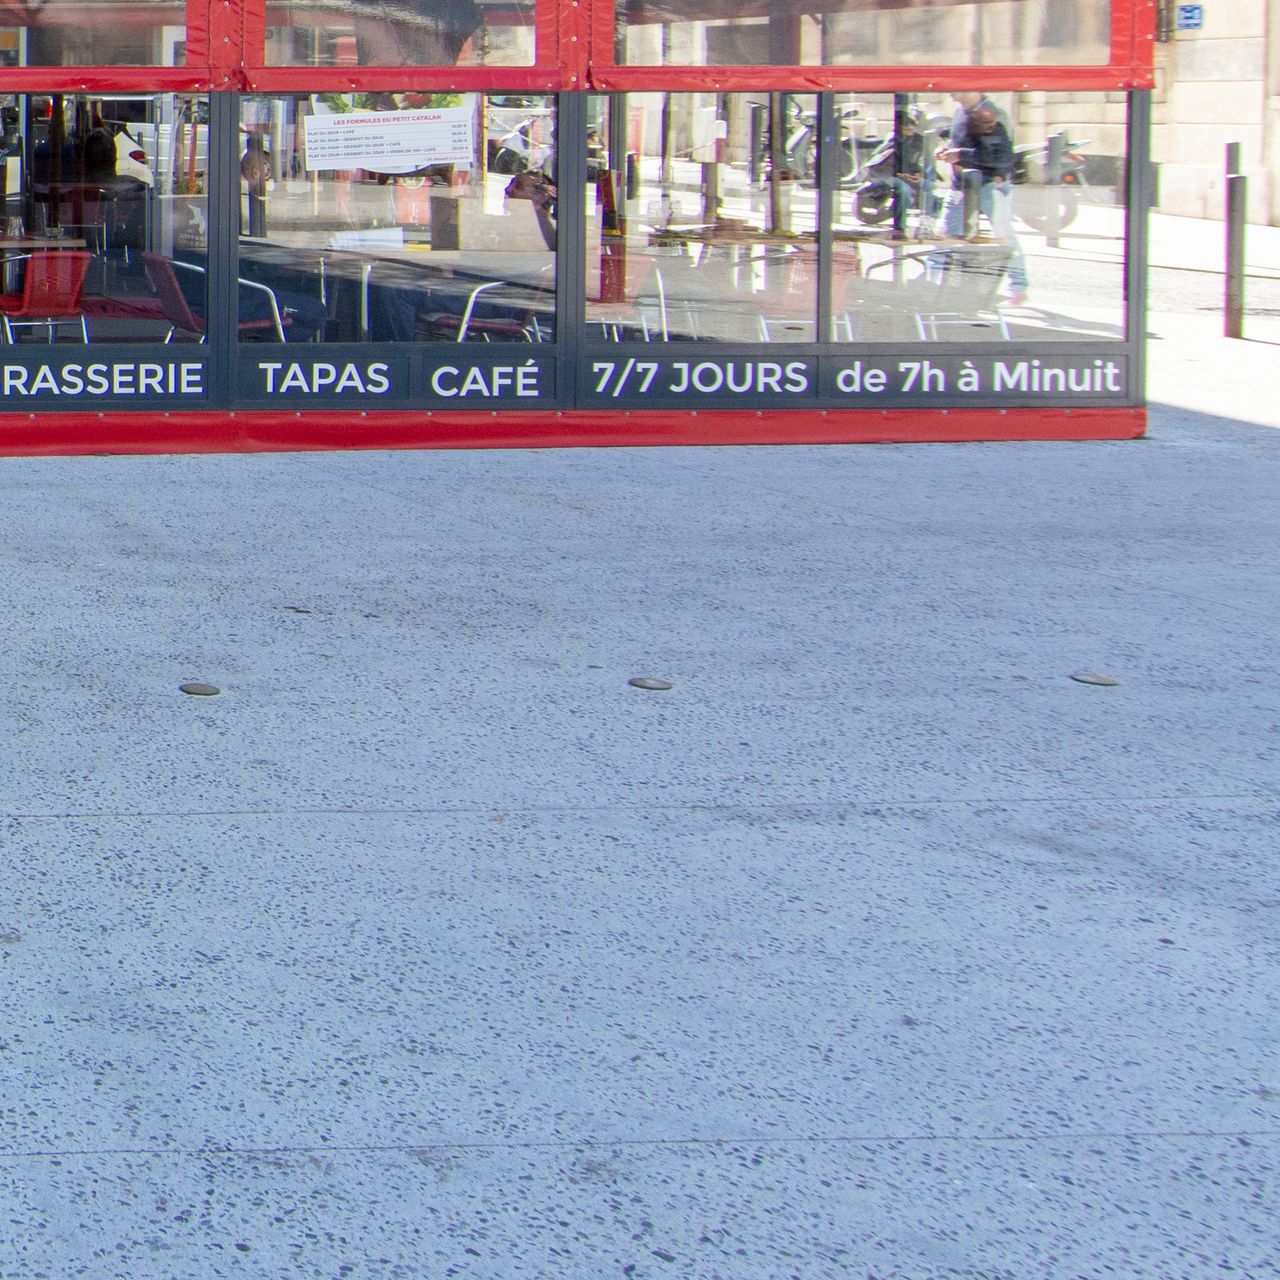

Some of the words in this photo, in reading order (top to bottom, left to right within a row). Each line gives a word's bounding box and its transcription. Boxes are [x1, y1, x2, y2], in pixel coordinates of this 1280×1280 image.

[258, 363, 390, 394] TAPAS
[431, 359, 539, 397] CAFÉ
[592, 358, 658, 397] 7/7
[670, 361, 809, 393] JOURS
[837, 361, 886, 392] de
[898, 361, 944, 392] 7h
[957, 361, 980, 392] à
[993, 359, 1121, 392] Minuit
